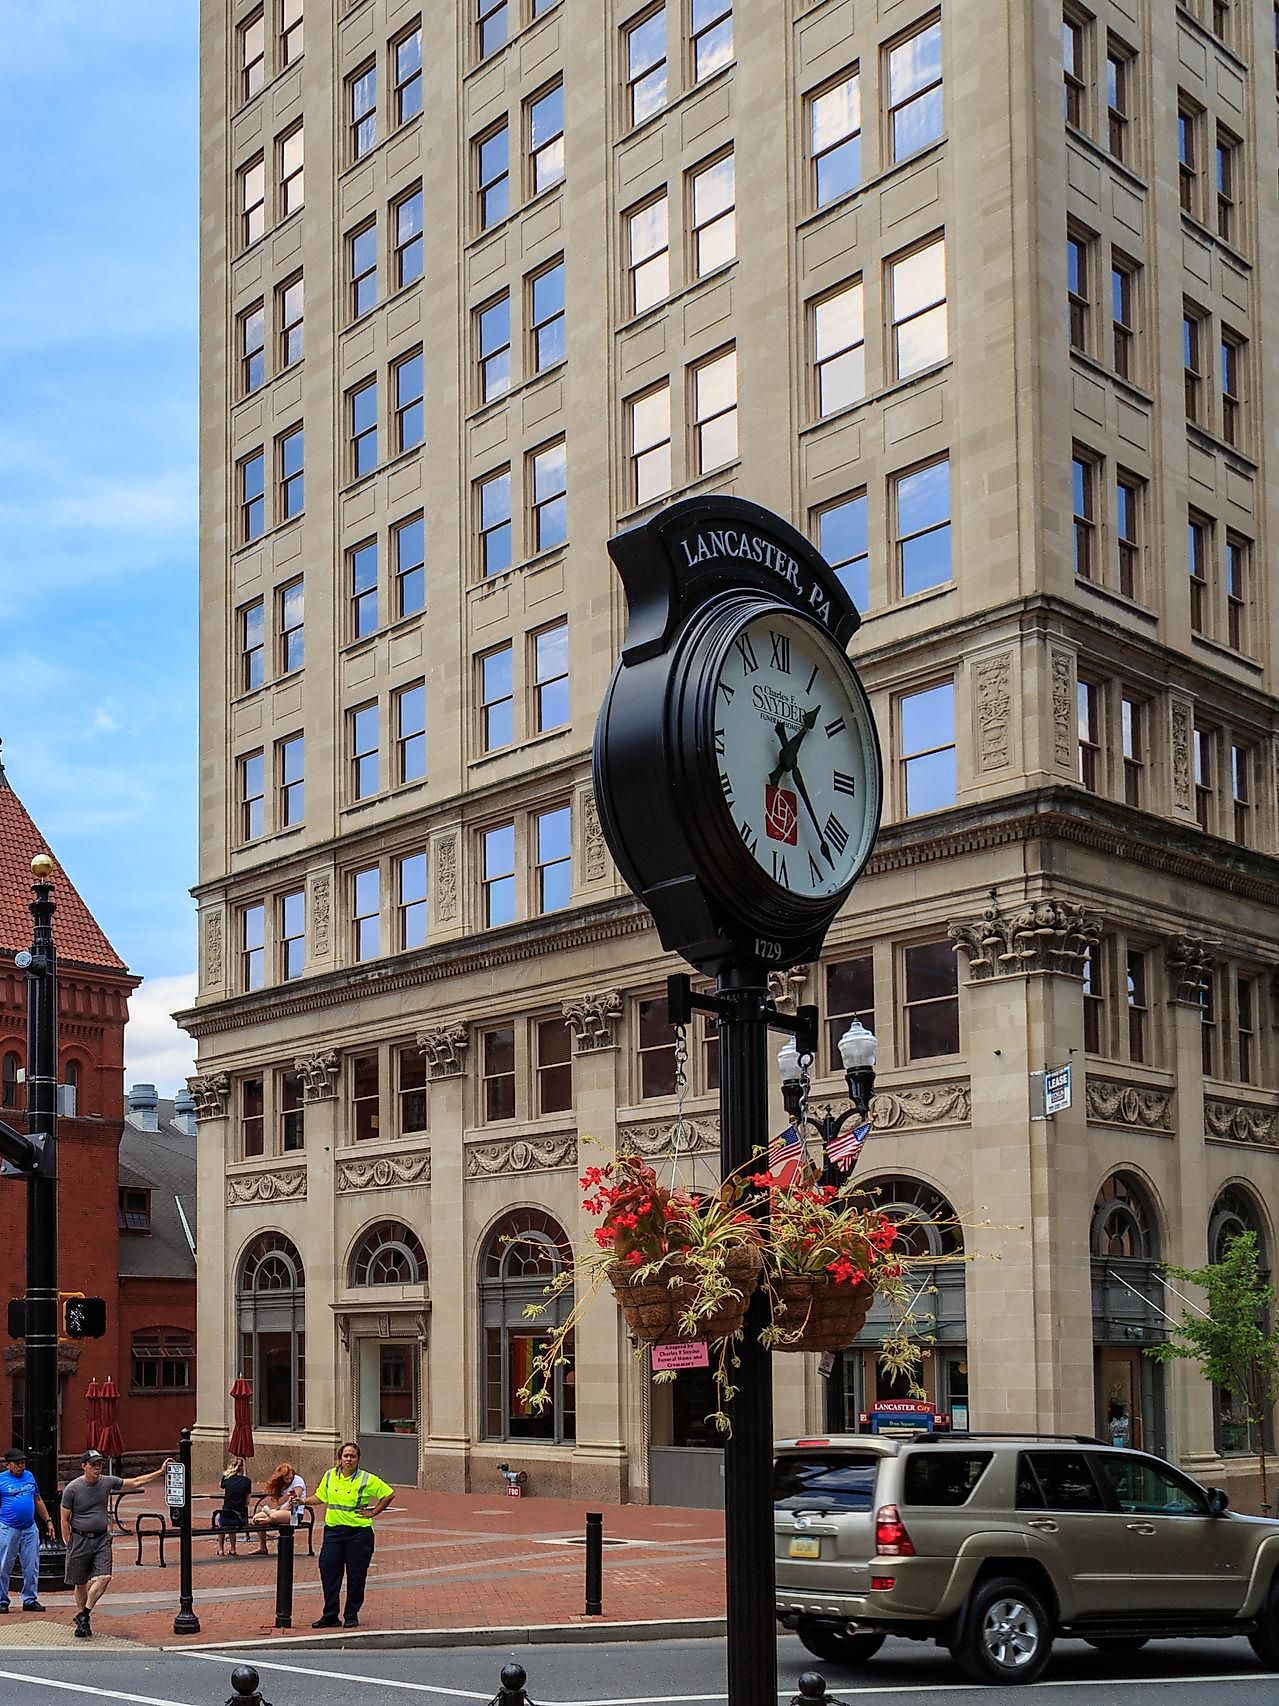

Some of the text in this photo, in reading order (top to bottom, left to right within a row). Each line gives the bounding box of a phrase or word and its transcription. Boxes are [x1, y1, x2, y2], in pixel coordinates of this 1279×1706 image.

[680, 530, 831, 625] LANCASTER, PA
[769, 630, 792, 675] XII
[764, 685, 789, 702] Charles
[833, 768, 855, 798] III
[754, 938, 782, 961] 1729
[1048, 1073, 1068, 1090] LEASE
[874, 1403, 930, 1412] LANCASTER City
[508, 1487, 519, 1496] FDC
